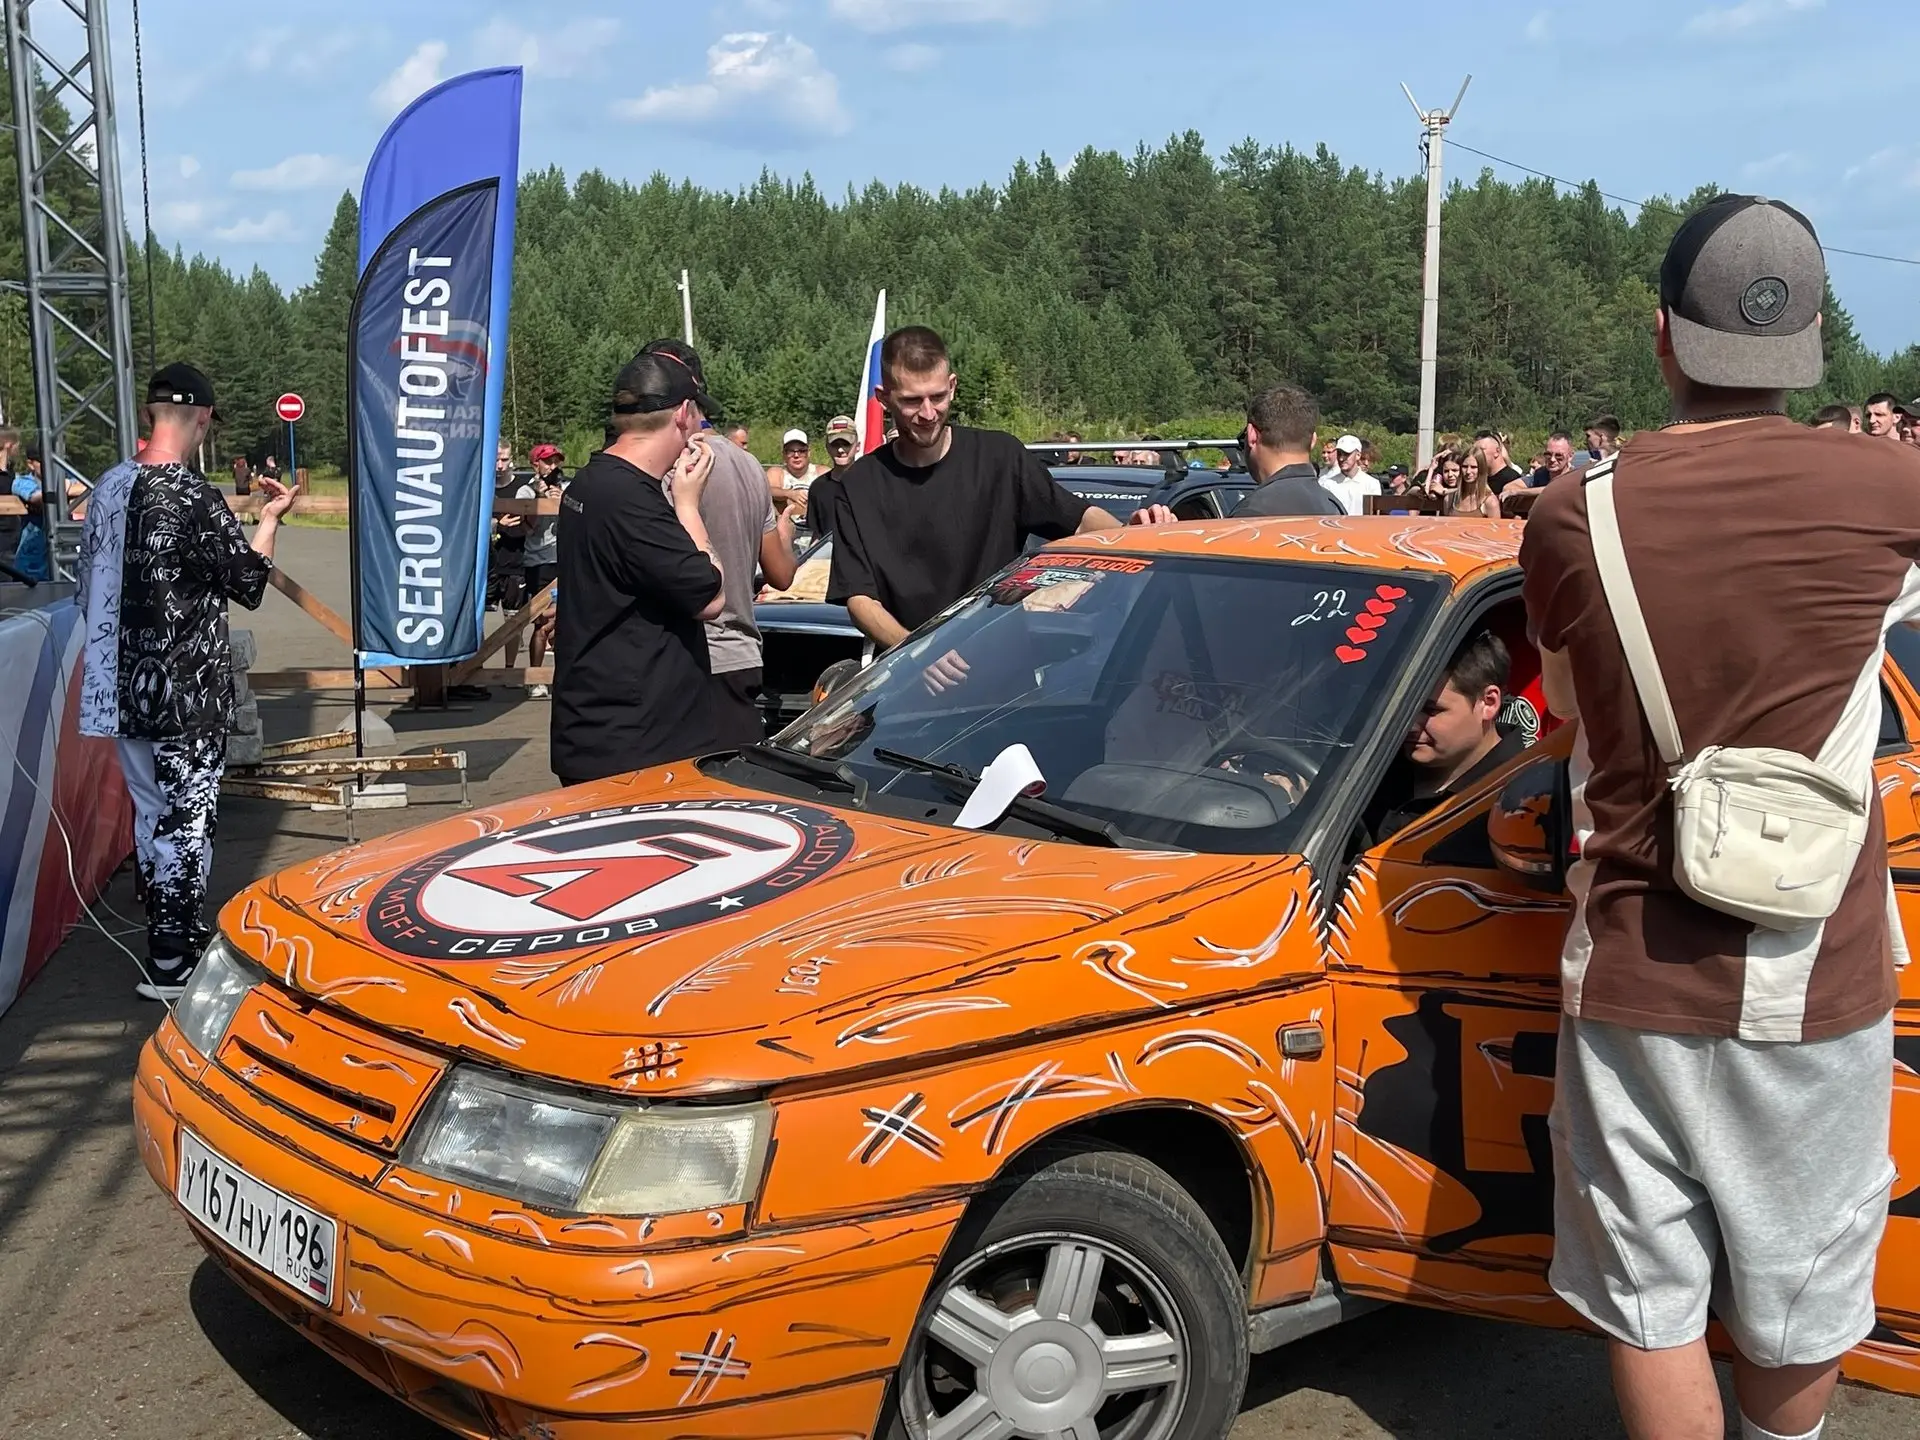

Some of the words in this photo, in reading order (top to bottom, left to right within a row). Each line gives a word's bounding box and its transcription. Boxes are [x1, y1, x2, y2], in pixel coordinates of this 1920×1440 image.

[395, 246, 452, 647] SEROVAUTOFEST
[140, 566, 182, 582] CARES
[1290, 589, 1350, 627] 22
[548, 801, 809, 827] FEDERAL
[766, 824, 841, 888] AUDIO
[449, 918, 660, 955] СЕРОВ
[186, 1154, 272, 1255] У167НУ
[280, 1208, 324, 1271] 196
[286, 1257, 309, 1284] RUS
